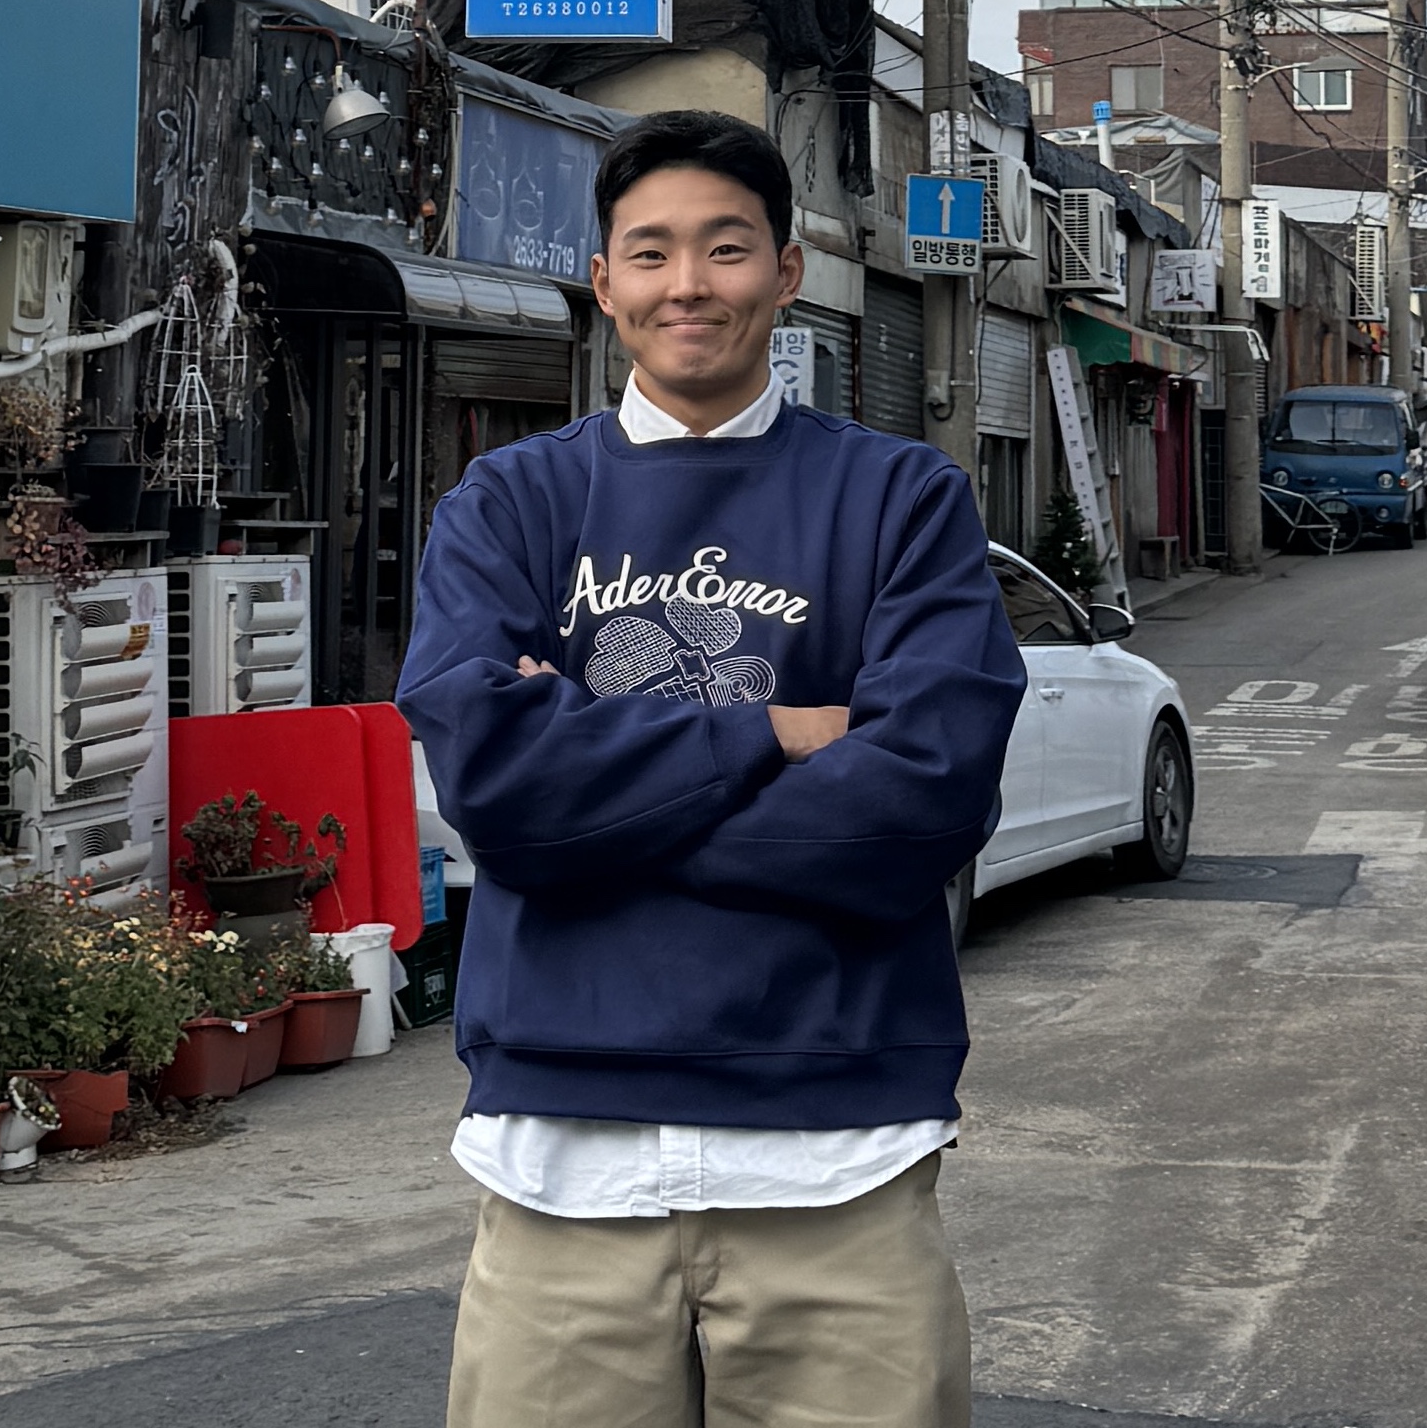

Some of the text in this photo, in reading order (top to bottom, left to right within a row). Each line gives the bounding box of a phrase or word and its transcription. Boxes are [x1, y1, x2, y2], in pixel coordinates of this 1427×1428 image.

[502, 1, 629, 16] T26380012
[513, 234, 575, 275] 2633-7719
[912, 239, 977, 267] 일방통행
